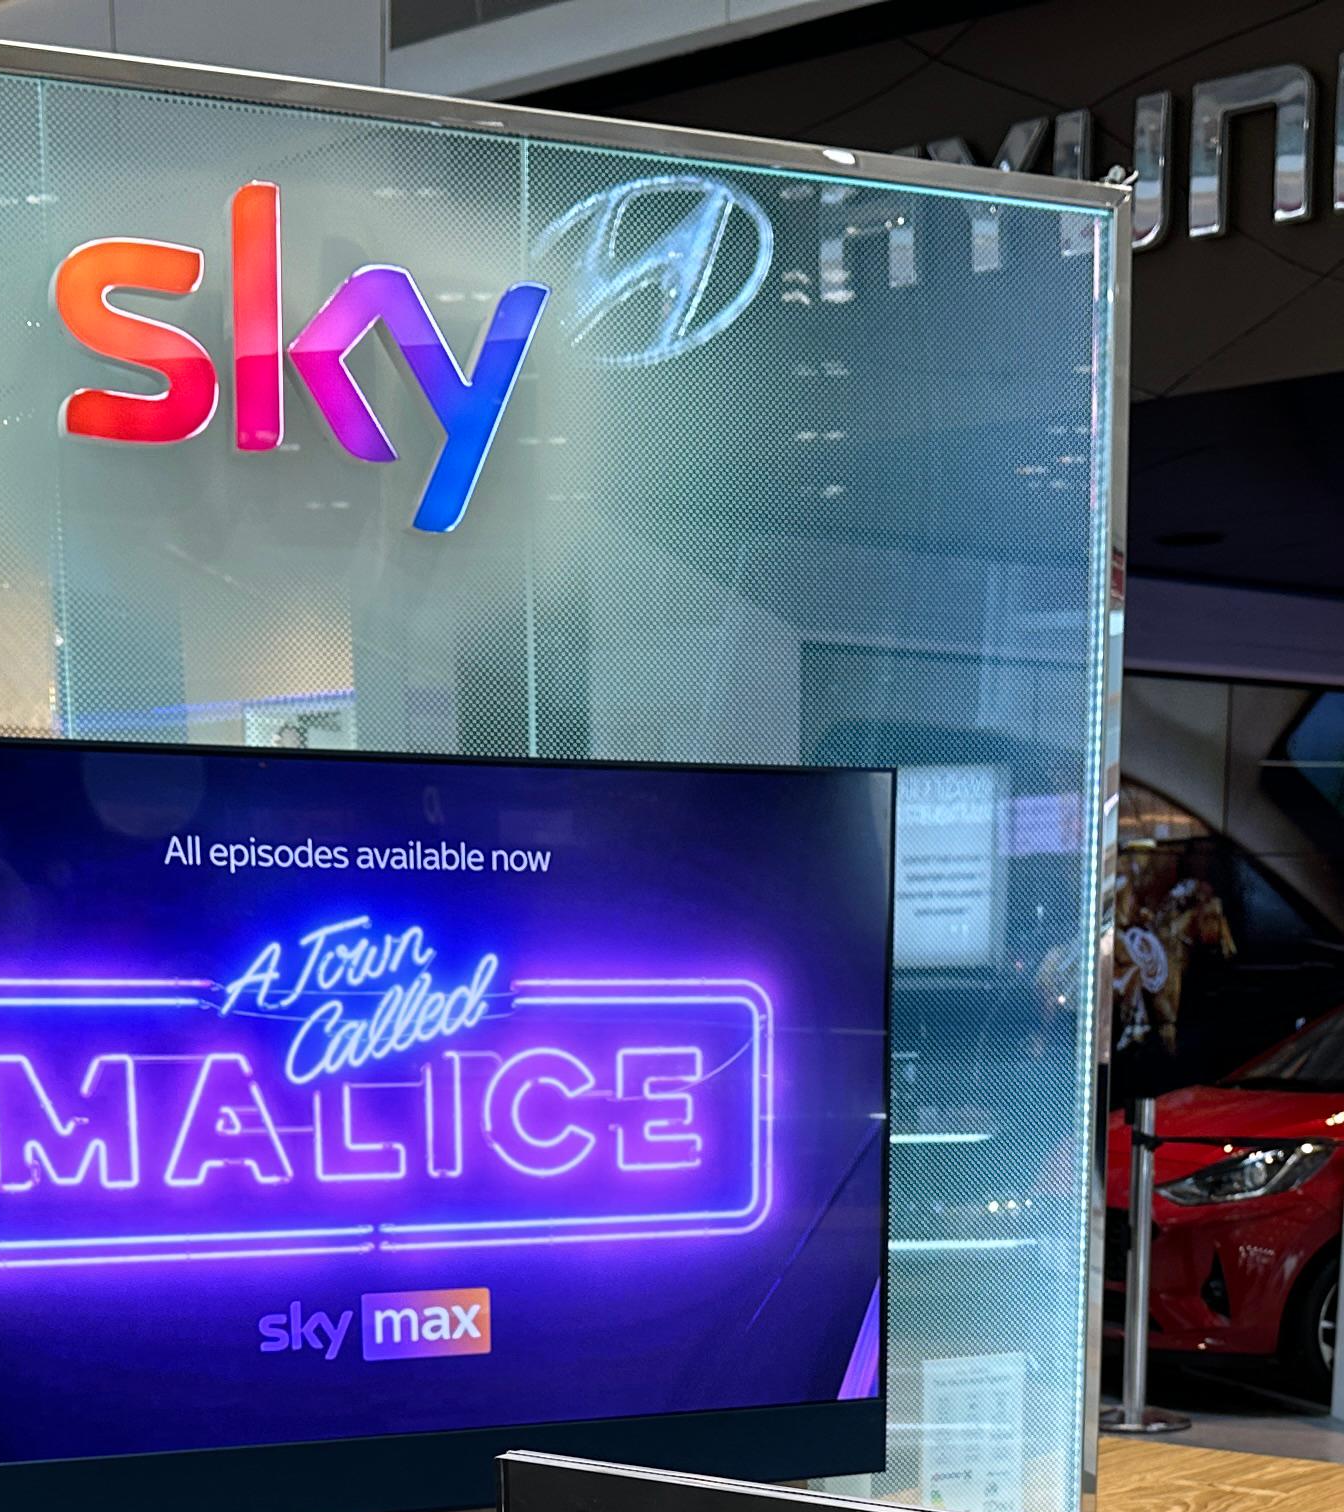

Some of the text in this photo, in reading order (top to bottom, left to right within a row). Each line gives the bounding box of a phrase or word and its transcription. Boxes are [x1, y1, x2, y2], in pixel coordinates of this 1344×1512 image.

[50, 178, 553, 535] sky
[164, 835, 552, 873] All episodes available now
[217, 914, 438, 1017] A Town
[285, 952, 499, 1084] Called
[258, 1300, 481, 1360] sky max
